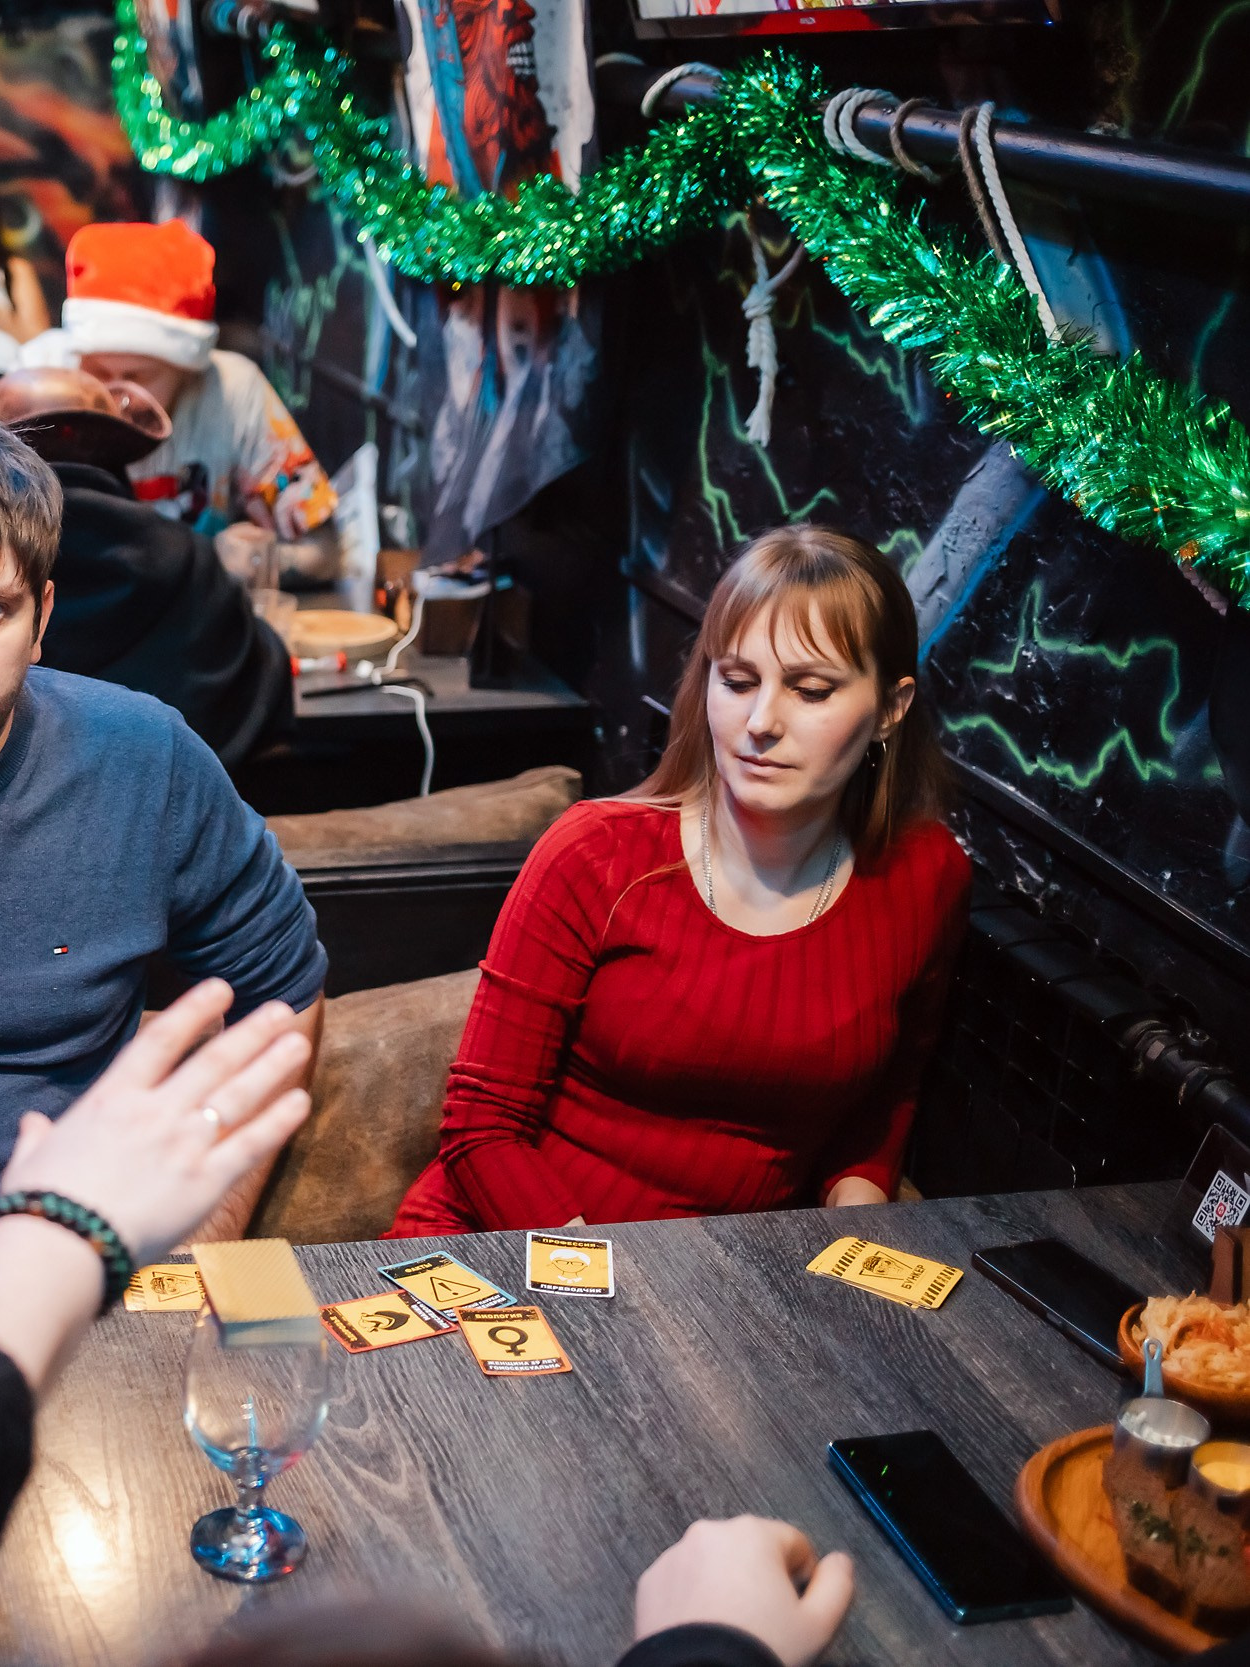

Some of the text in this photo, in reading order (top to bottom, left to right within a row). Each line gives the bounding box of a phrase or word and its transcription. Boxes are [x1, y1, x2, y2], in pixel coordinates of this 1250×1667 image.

[541, 1238, 596, 1248] ПРОФЕССИЯ
[404, 1263, 433, 1273] ФАКТЫ
[901, 1264, 927, 1290] БУНКЕР
[540, 1283, 603, 1294] ПЕРЕВОДЧИК
[488, 1363, 561, 1371] ГОМОСЕКСУАЛЬНА
